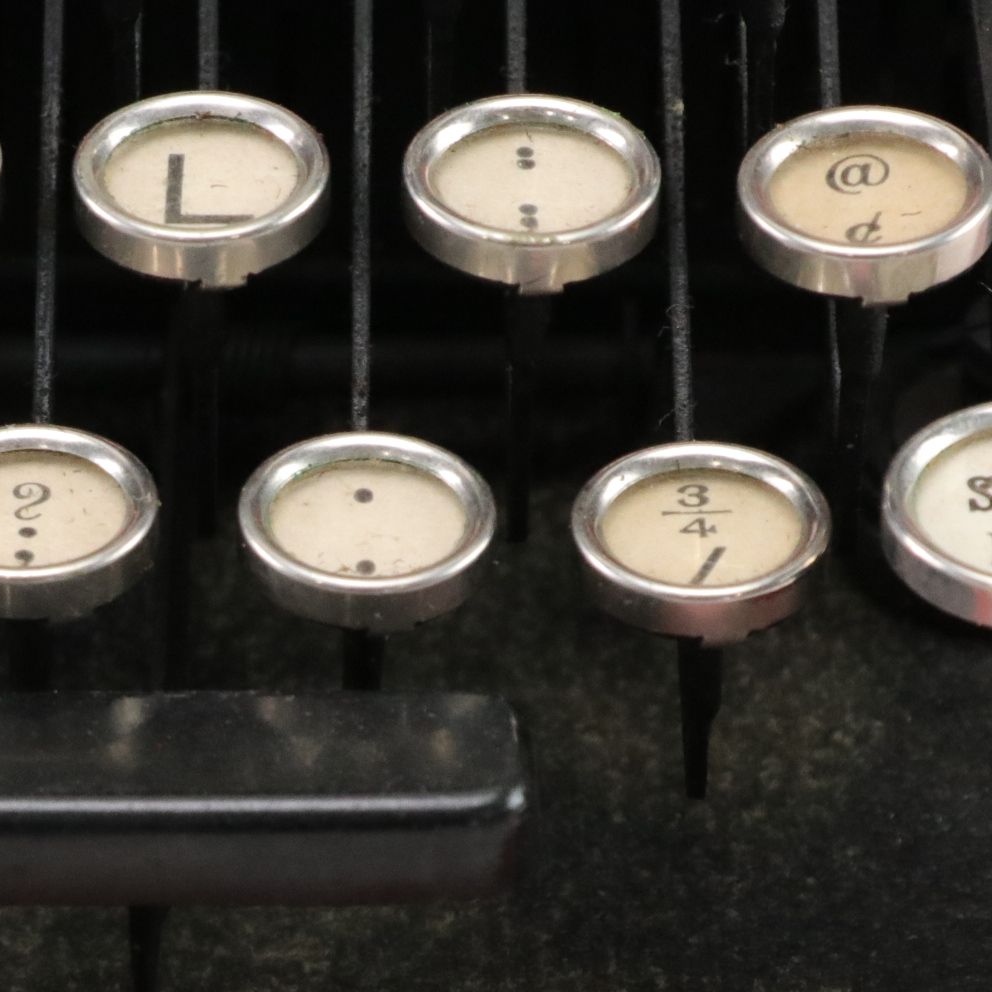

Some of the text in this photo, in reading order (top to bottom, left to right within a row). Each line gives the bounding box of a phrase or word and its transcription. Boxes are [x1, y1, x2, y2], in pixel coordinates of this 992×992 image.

[164, 153, 254, 224] L
[825, 153, 890, 195] @
[12, 482, 51, 538] ?
